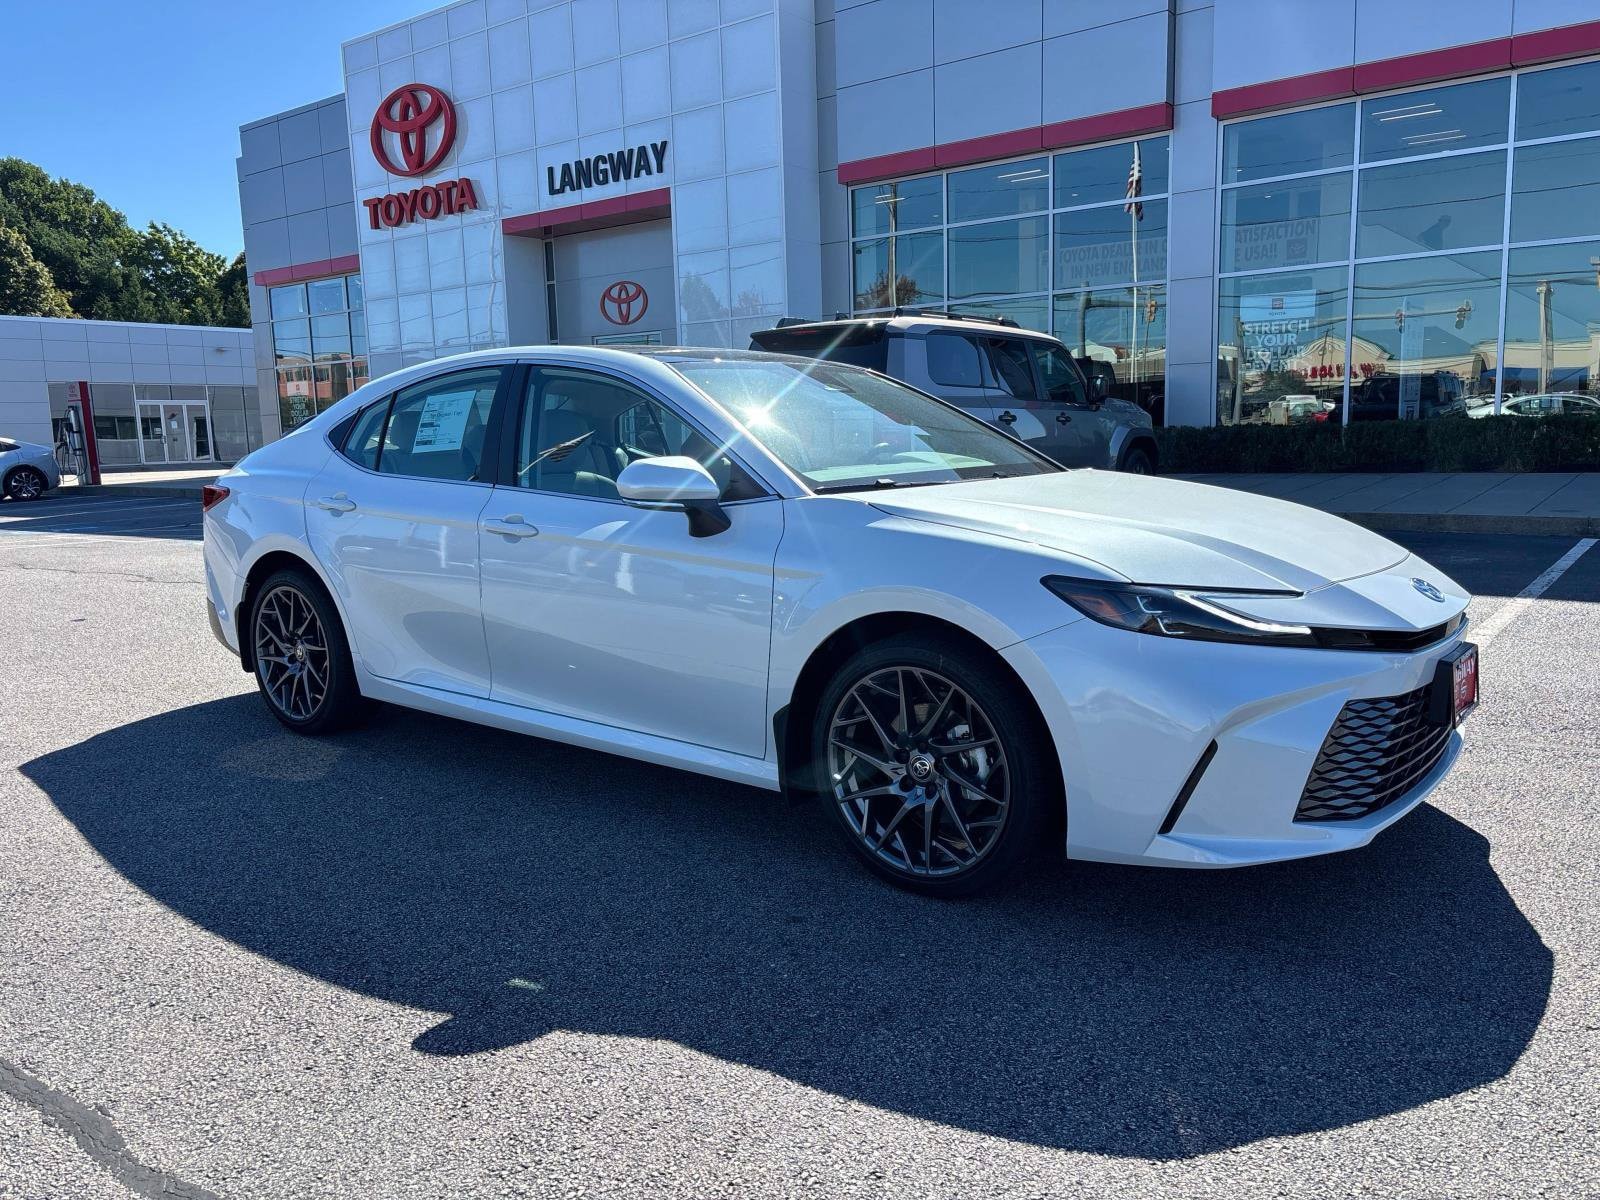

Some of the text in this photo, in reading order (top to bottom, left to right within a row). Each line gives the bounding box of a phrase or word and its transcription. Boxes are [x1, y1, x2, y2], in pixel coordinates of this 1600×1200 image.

[547, 140, 668, 196] LANGWAY
[362, 177, 478, 230] TOYOTA
[1236, 221, 1315, 244] ATISFACTION
[1243, 319, 1310, 336] STRETCH
[1255, 333, 1298, 348] YOUR
